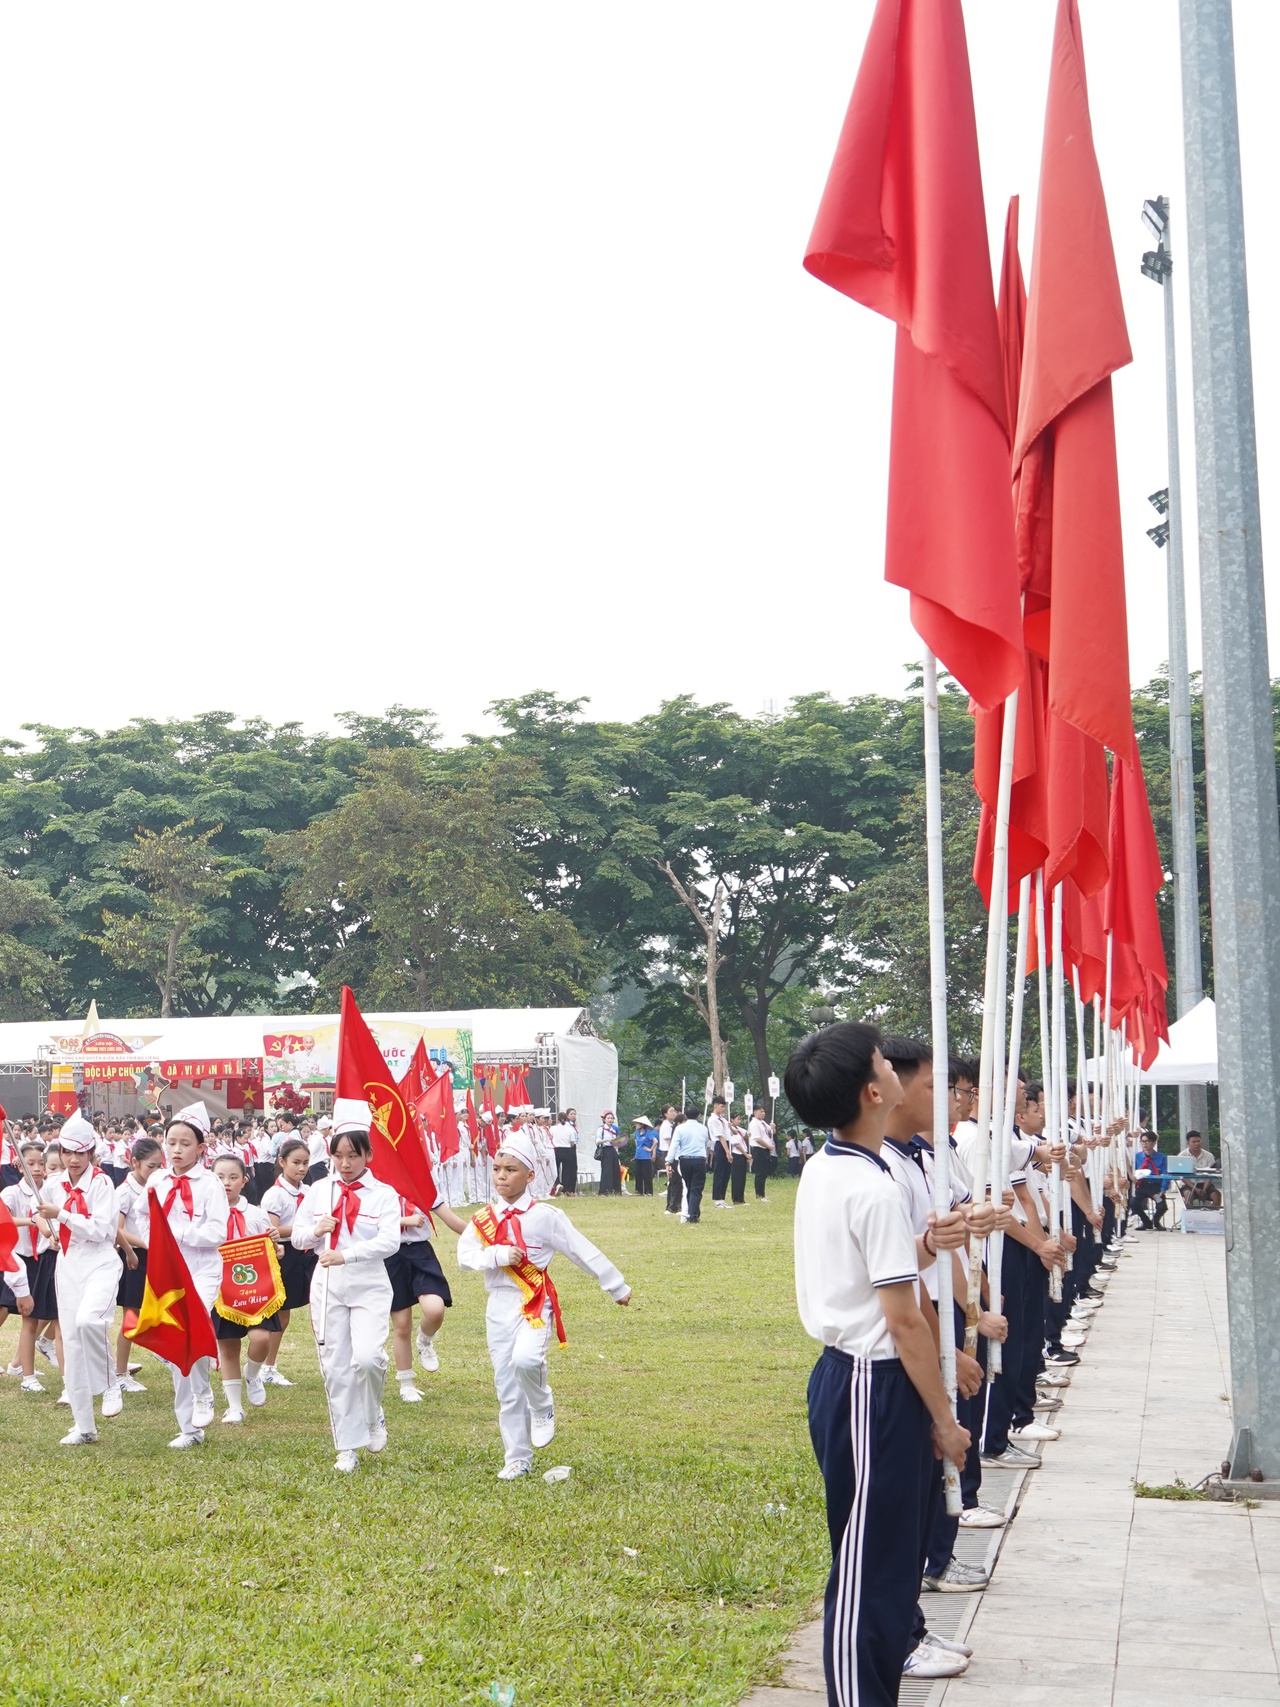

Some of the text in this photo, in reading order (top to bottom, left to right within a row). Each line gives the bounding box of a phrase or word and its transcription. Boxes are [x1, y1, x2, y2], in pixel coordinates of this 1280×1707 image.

[383, 1047, 406, 1058] ƯỚC
[85, 1065, 101, 1080] ĐỘC
[102, 1065, 117, 1080] LẬP
[118, 1063, 134, 1077] CHỦ
[231, 1263, 258, 1285] 85
[521, 1263, 543, 1288] MINH
